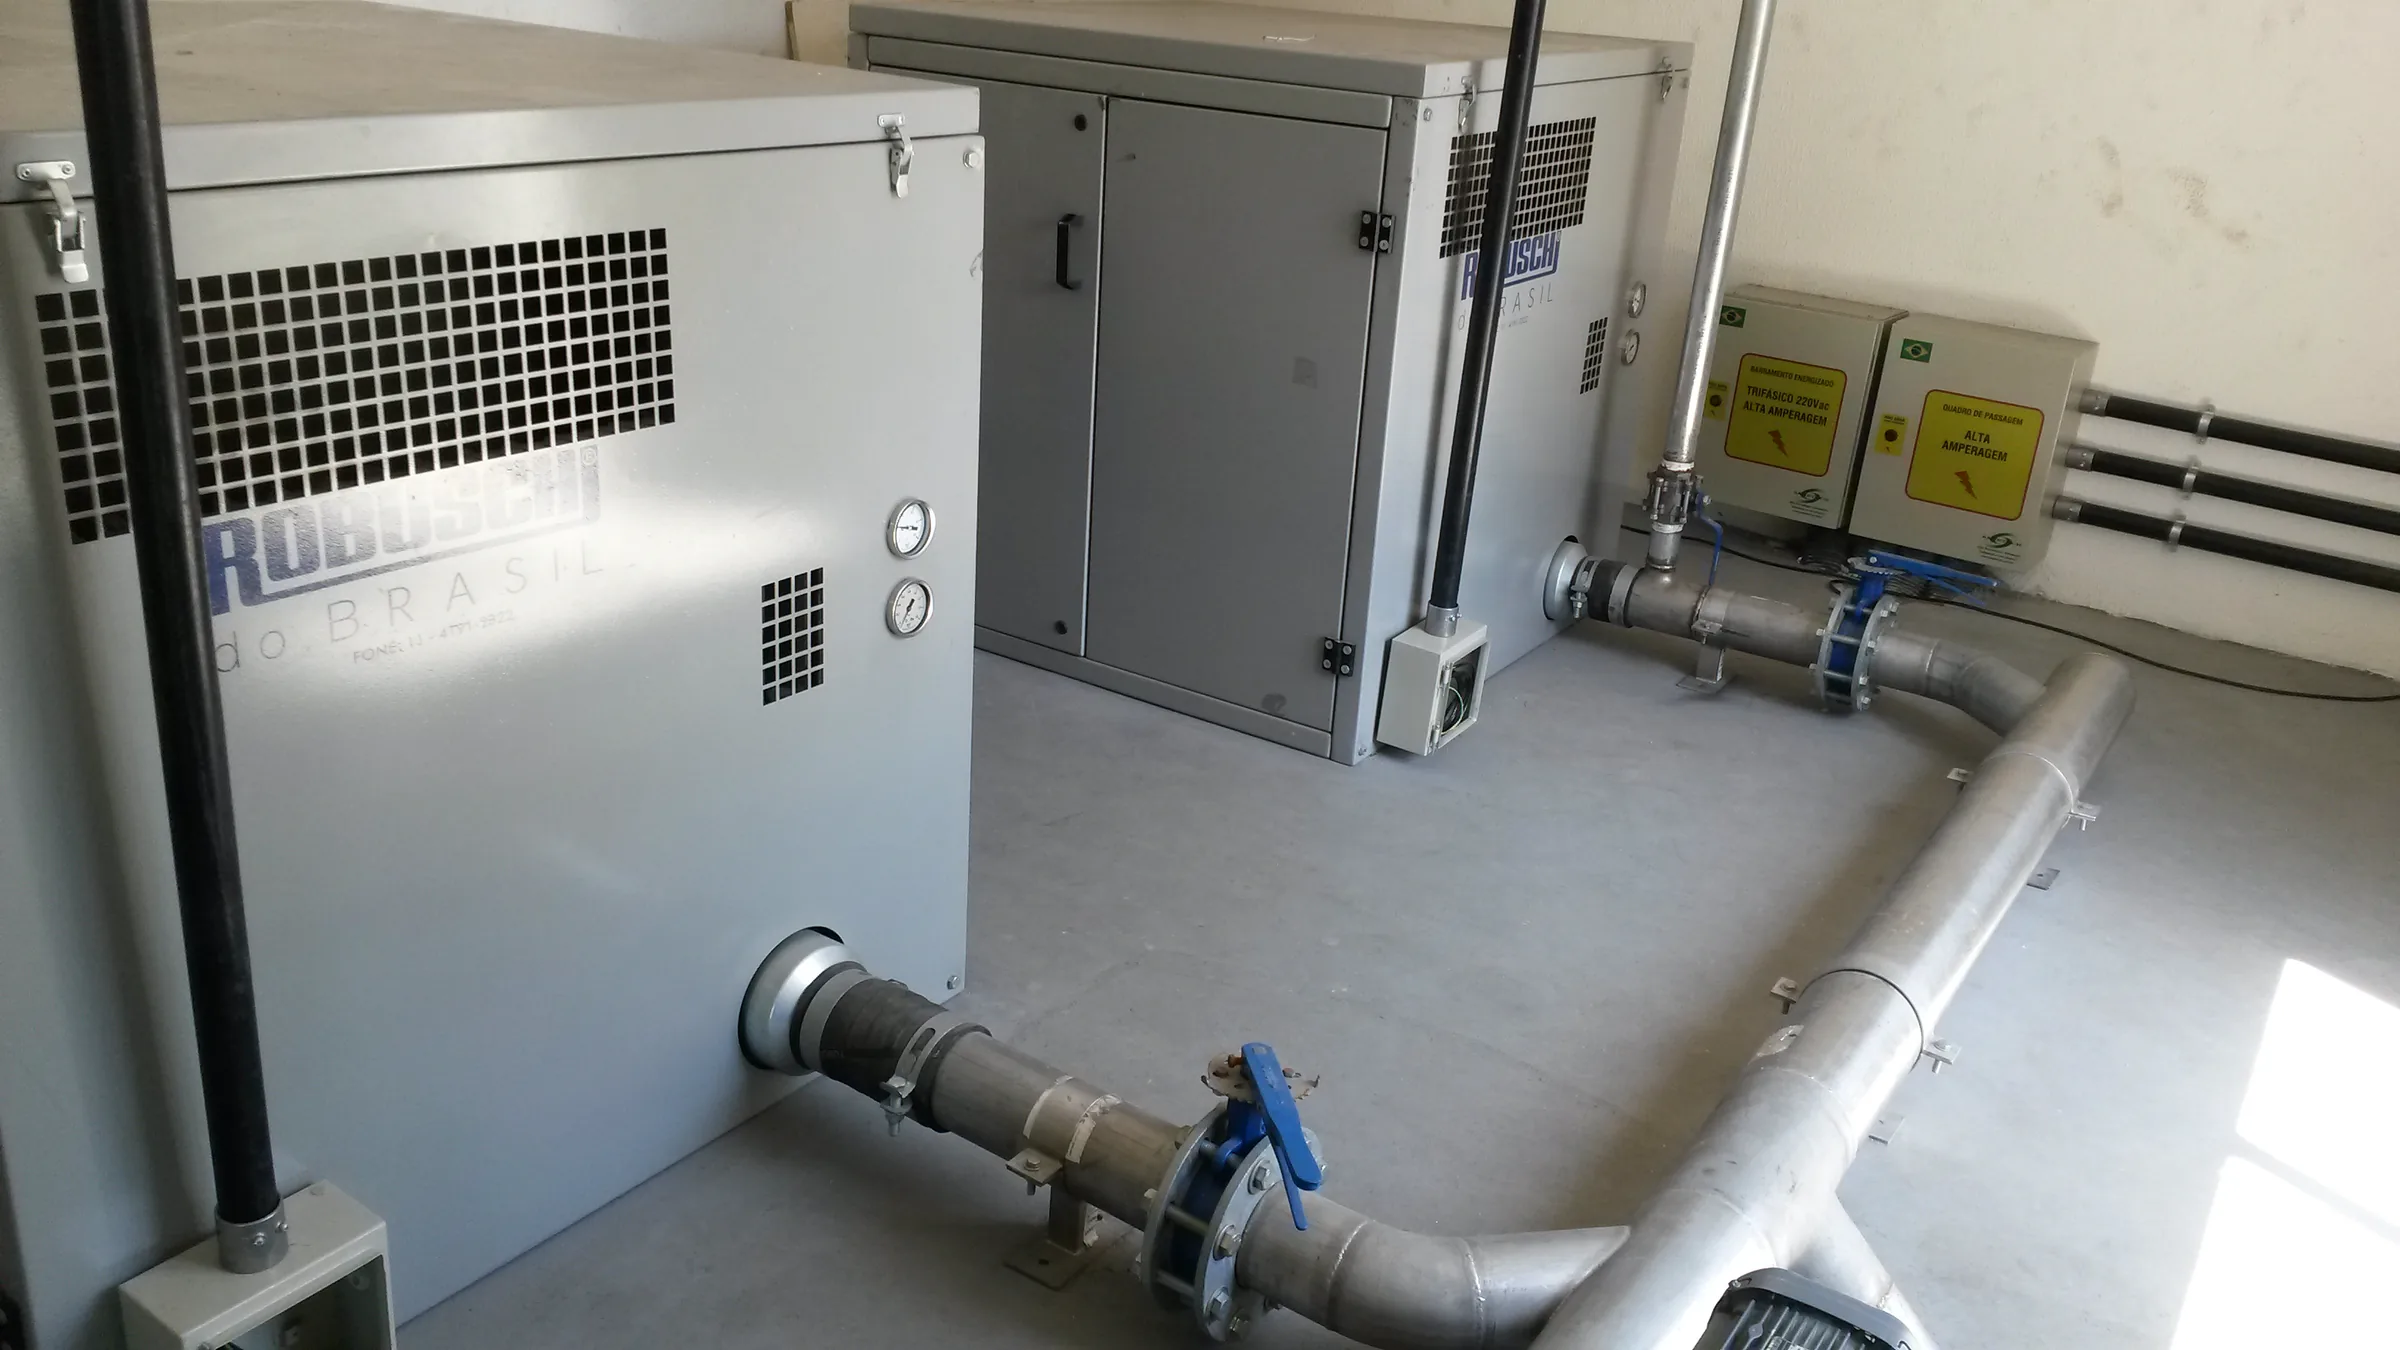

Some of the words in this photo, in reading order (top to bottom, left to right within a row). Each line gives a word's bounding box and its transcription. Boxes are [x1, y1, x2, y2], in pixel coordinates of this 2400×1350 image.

[1461, 231, 1562, 301] RUSCHI
[1500, 282, 1553, 316] RASIL
[1750, 365, 1794, 381] BARRAMENTO
[1794, 372, 1835, 388] ENERGIZADO
[1747, 385, 1794, 404] TRIFÁSICO
[1796, 394, 1830, 411] 220Vac
[1743, 401, 1766, 414] ALTA
[1768, 403, 1828, 426] AMPERAGEM
[1942, 403, 1973, 417] QUADRO
[1973, 409, 1984, 419] DE
[1984, 411, 2024, 426] PASSAGEM
[1964, 430, 1991, 444] ALTA
[1941, 440, 2008, 462] AMPERAGEM
[203, 444, 600, 616] ROBUSCHI
[215, 630, 286, 673] do
[327, 539, 604, 643] BRASIL
